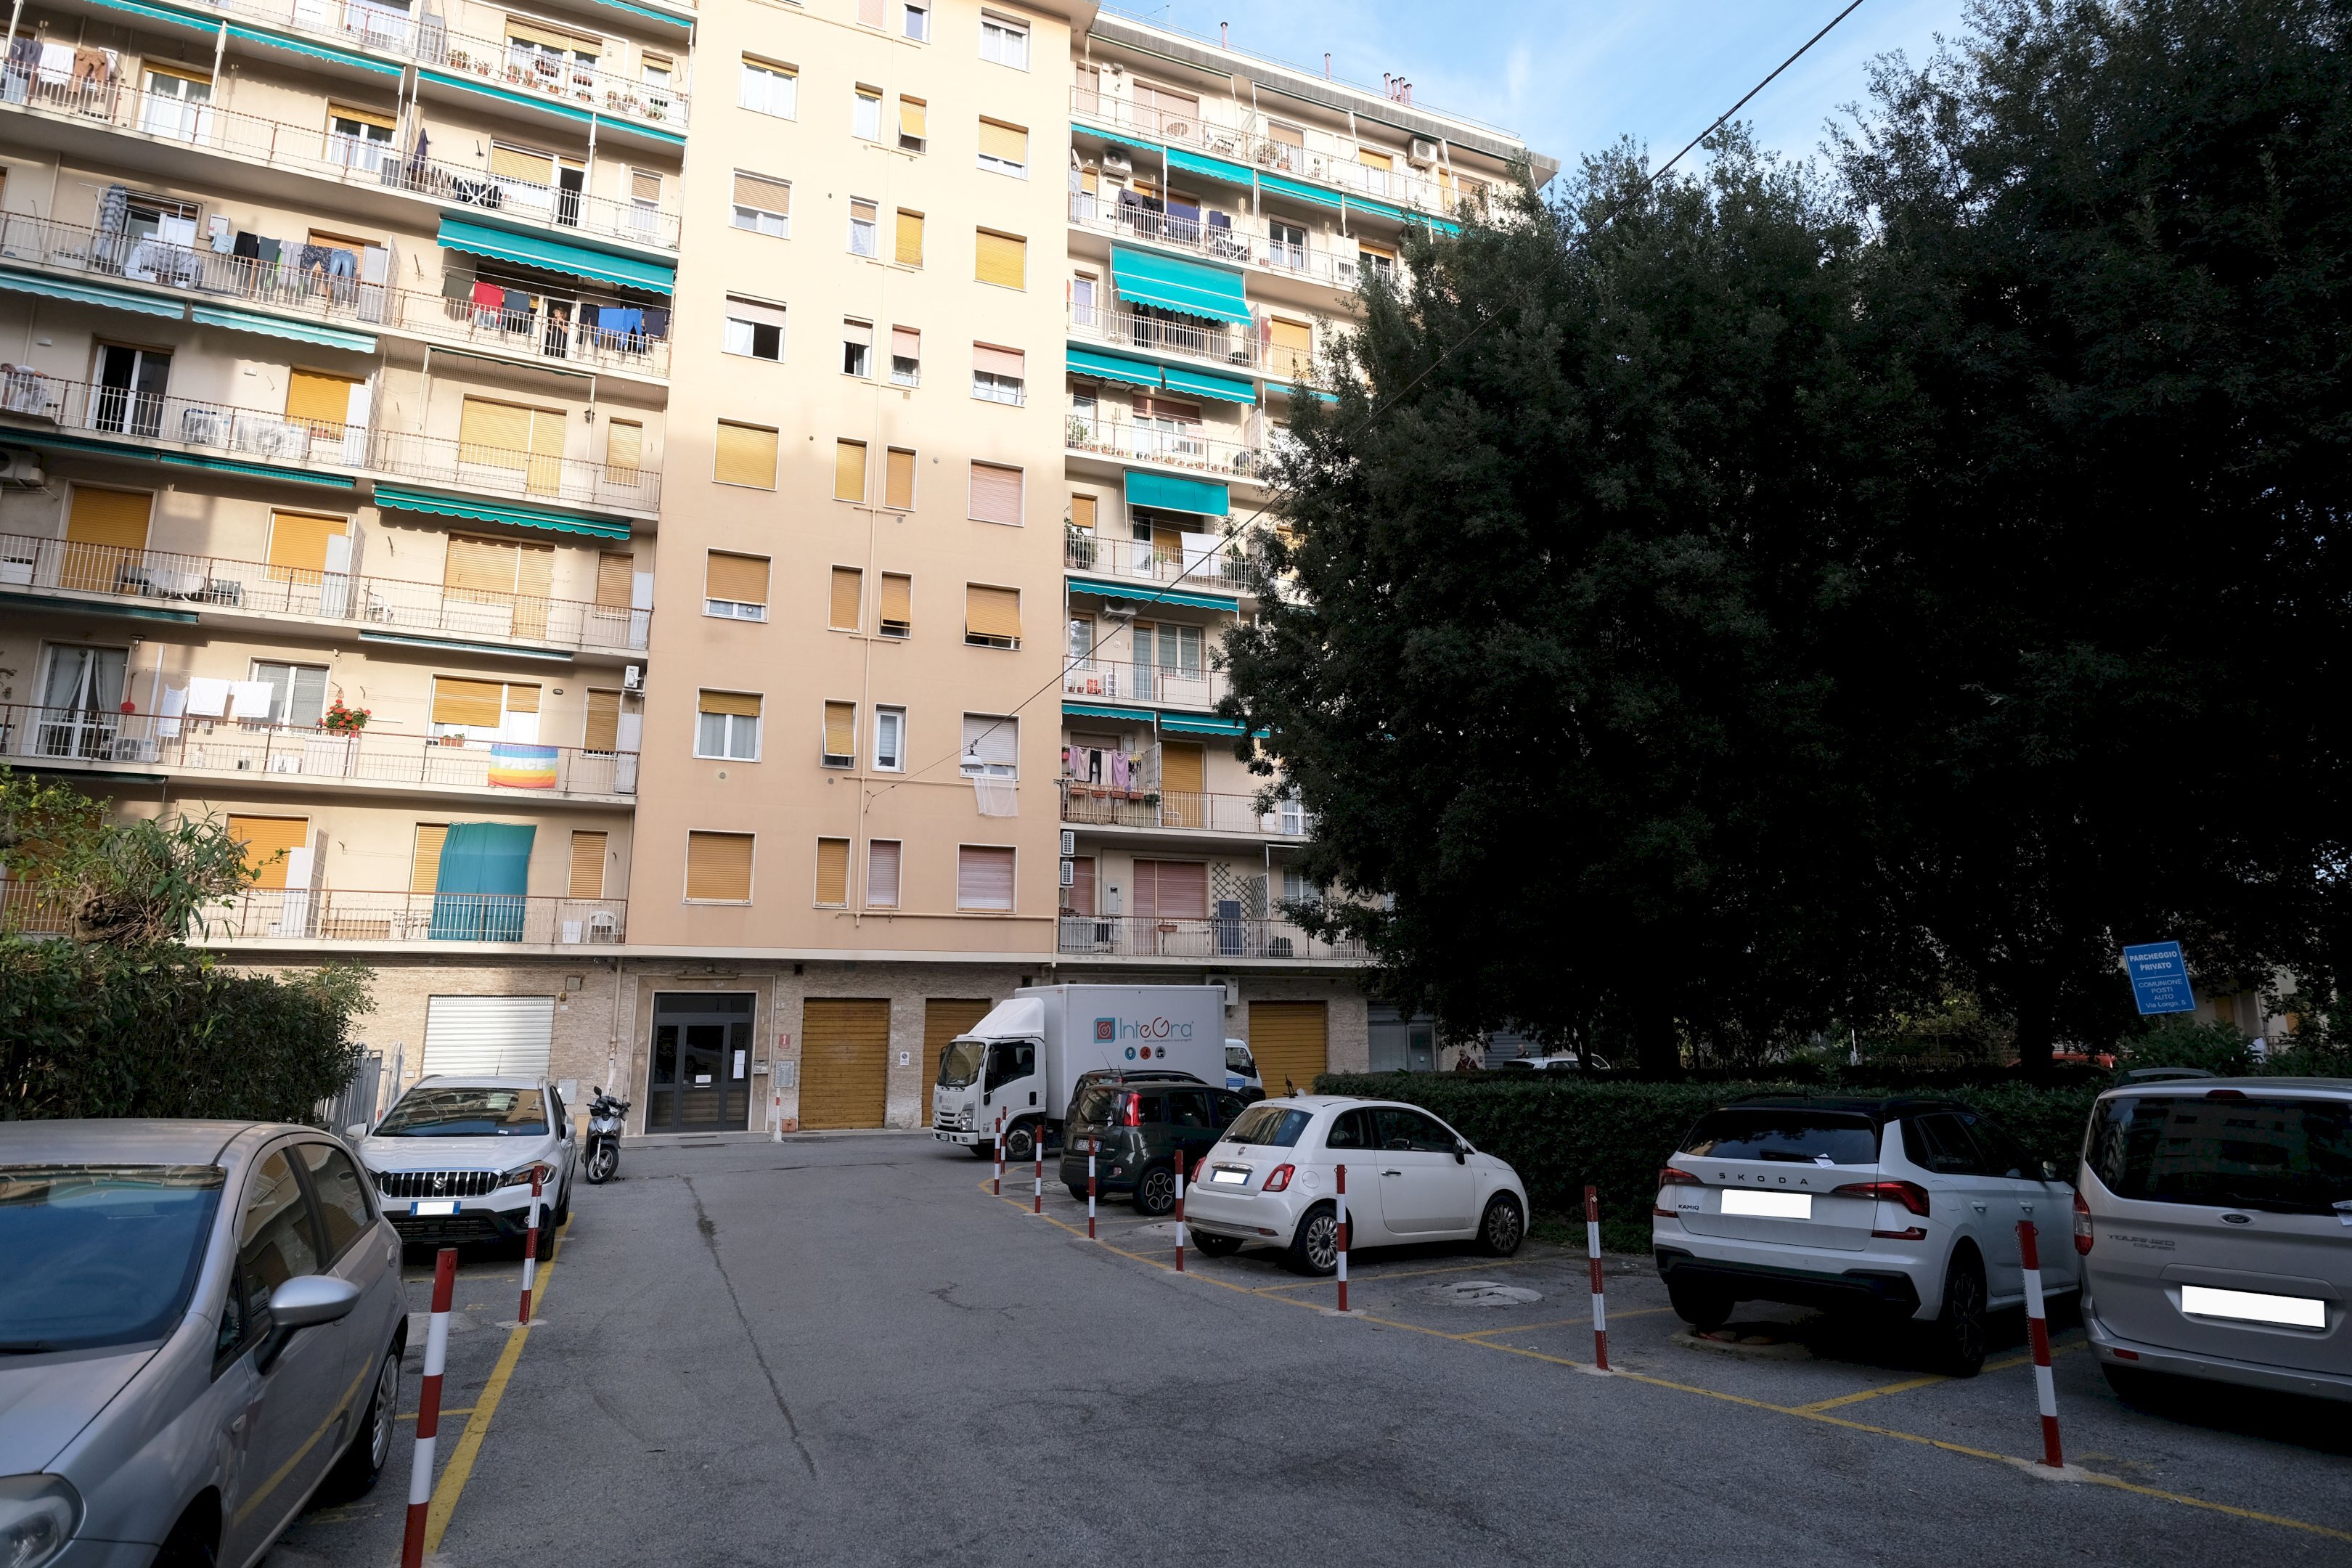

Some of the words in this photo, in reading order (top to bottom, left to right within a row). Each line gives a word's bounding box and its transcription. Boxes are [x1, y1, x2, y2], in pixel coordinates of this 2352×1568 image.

[499, 757, 547, 769] PACE
[2129, 951, 2177, 962] PARCHEGGIO
[2139, 962, 2172, 971] PRIVATO
[2138, 979, 2183, 988] COMUNIONE
[1718, 1172, 1808, 1185] SKODA
